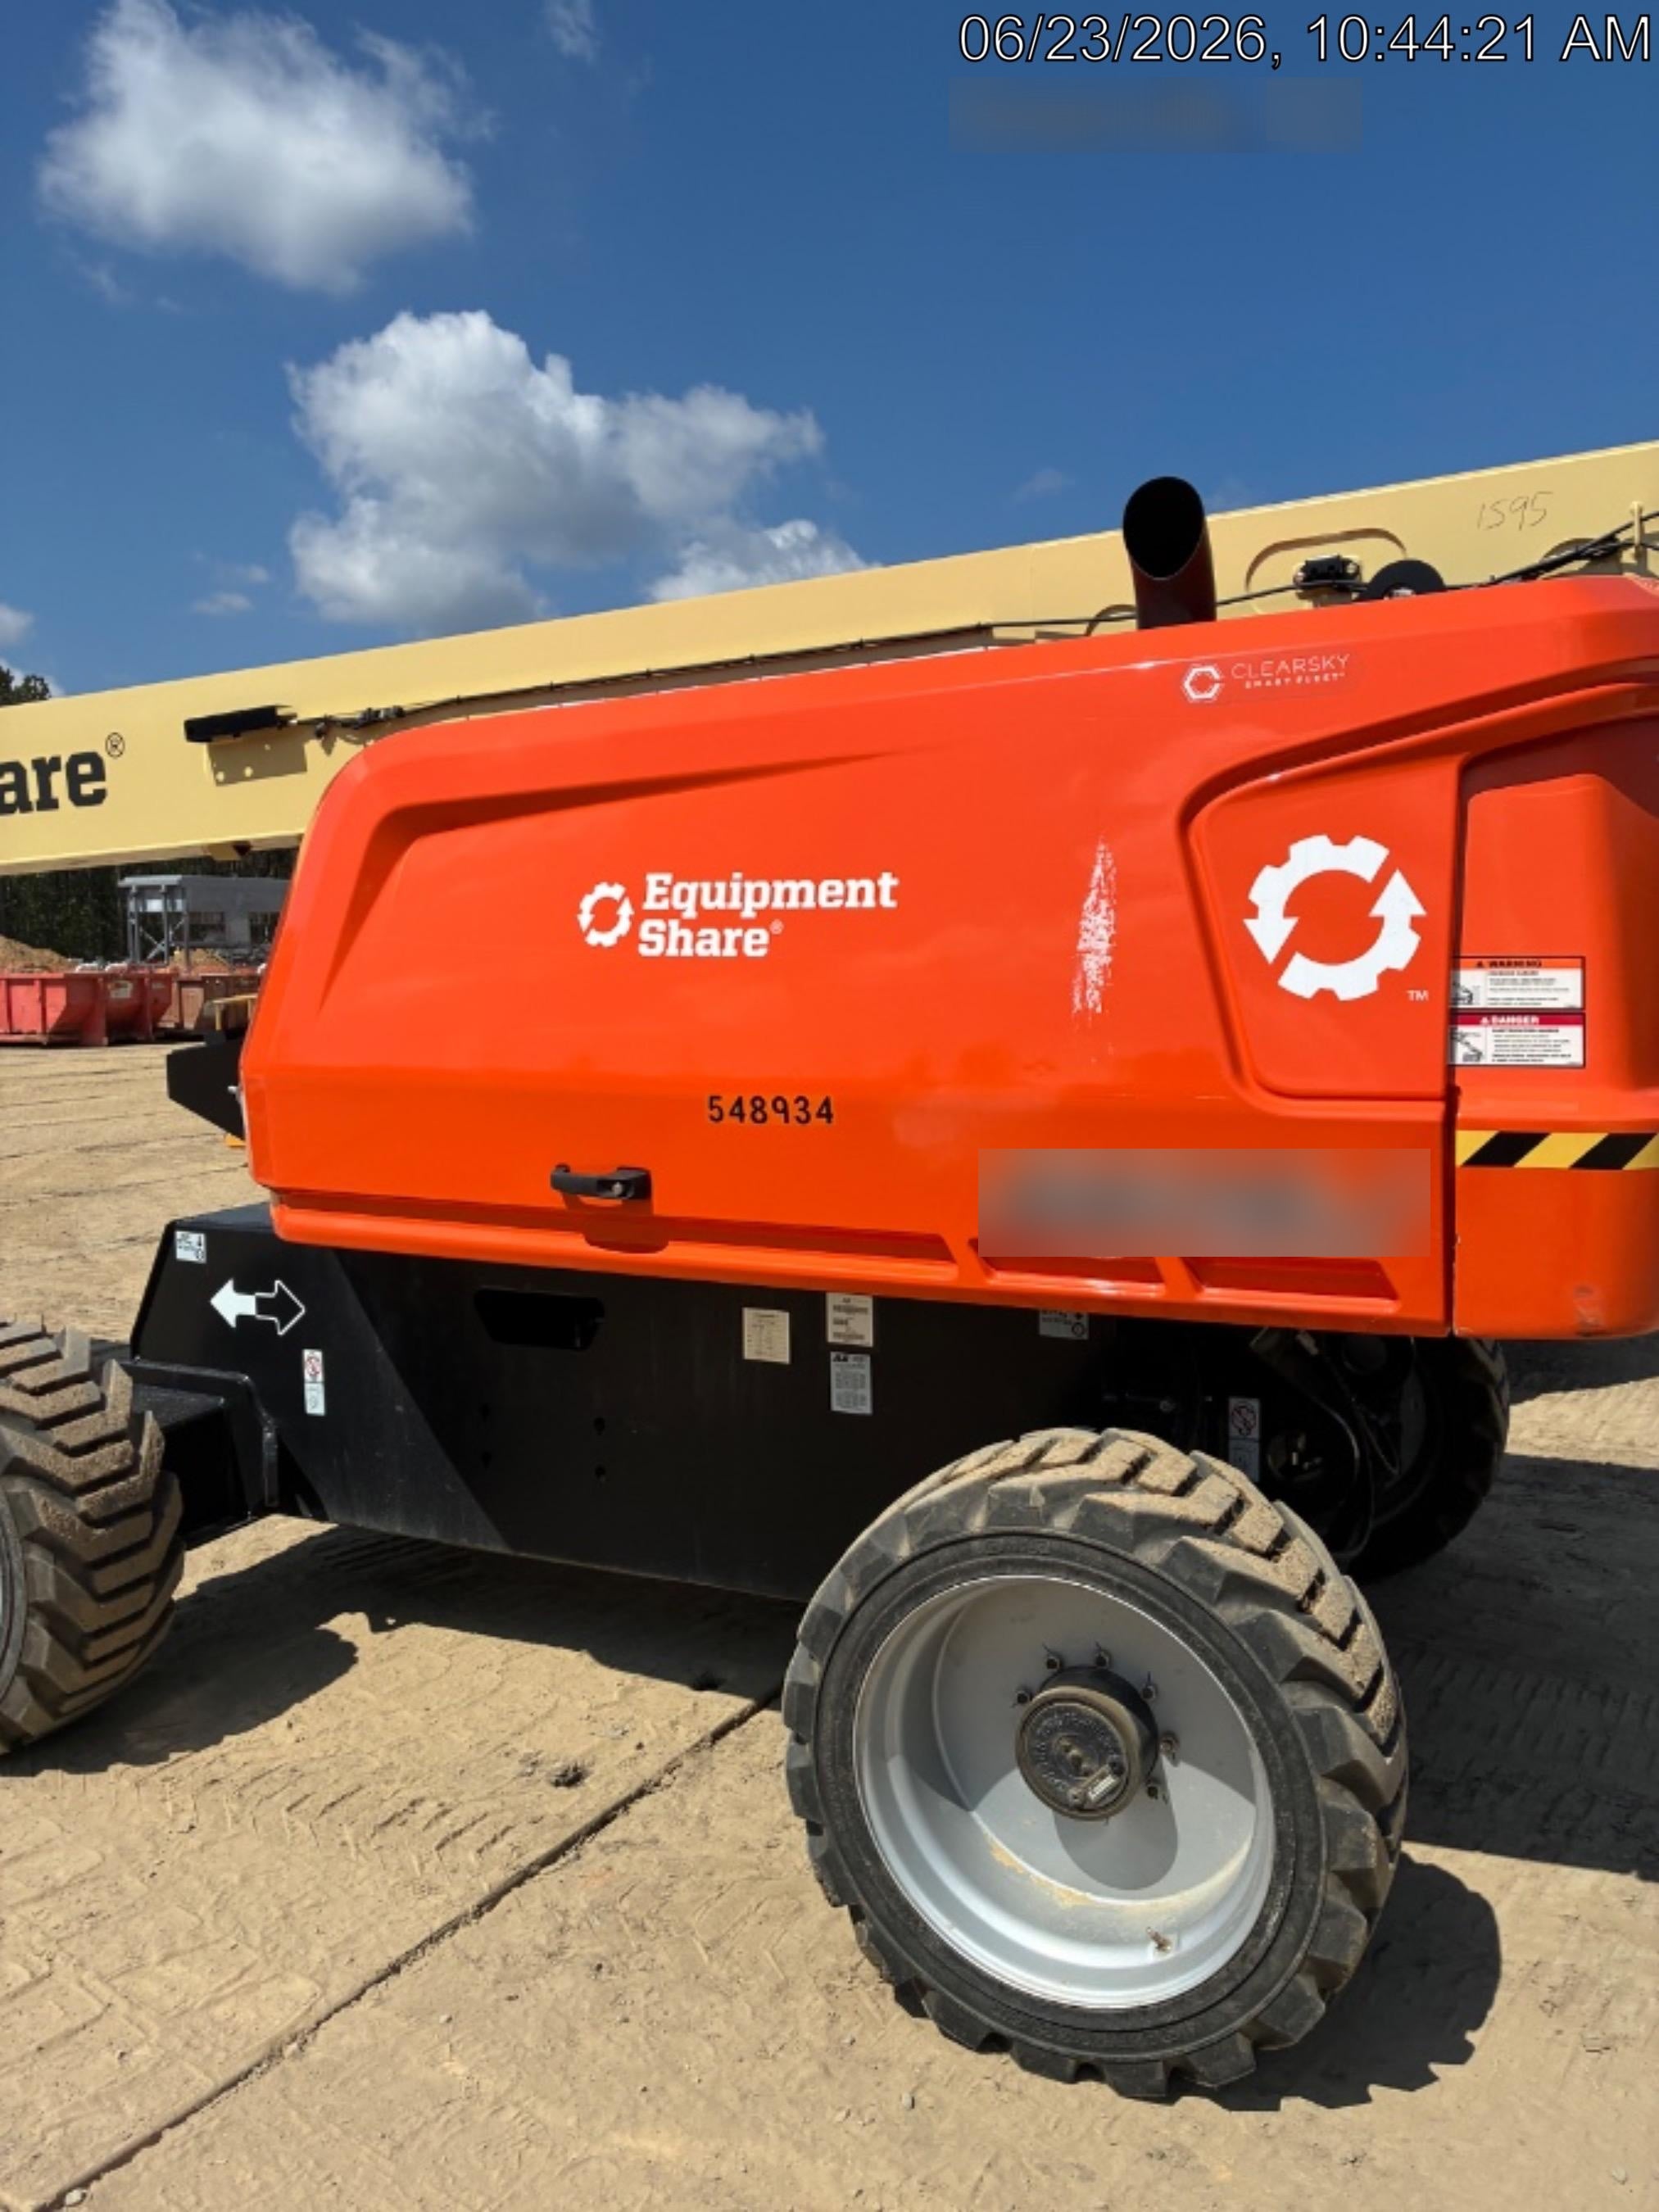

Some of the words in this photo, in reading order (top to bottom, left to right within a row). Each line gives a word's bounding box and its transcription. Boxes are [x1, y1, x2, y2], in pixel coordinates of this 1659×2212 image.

[1231, 653, 1351, 679] CLEARSKY
[642, 872, 900, 918] Equipment
[1491, 1015, 1540, 1025] DANGER
[708, 1095, 834, 1125] 548934
